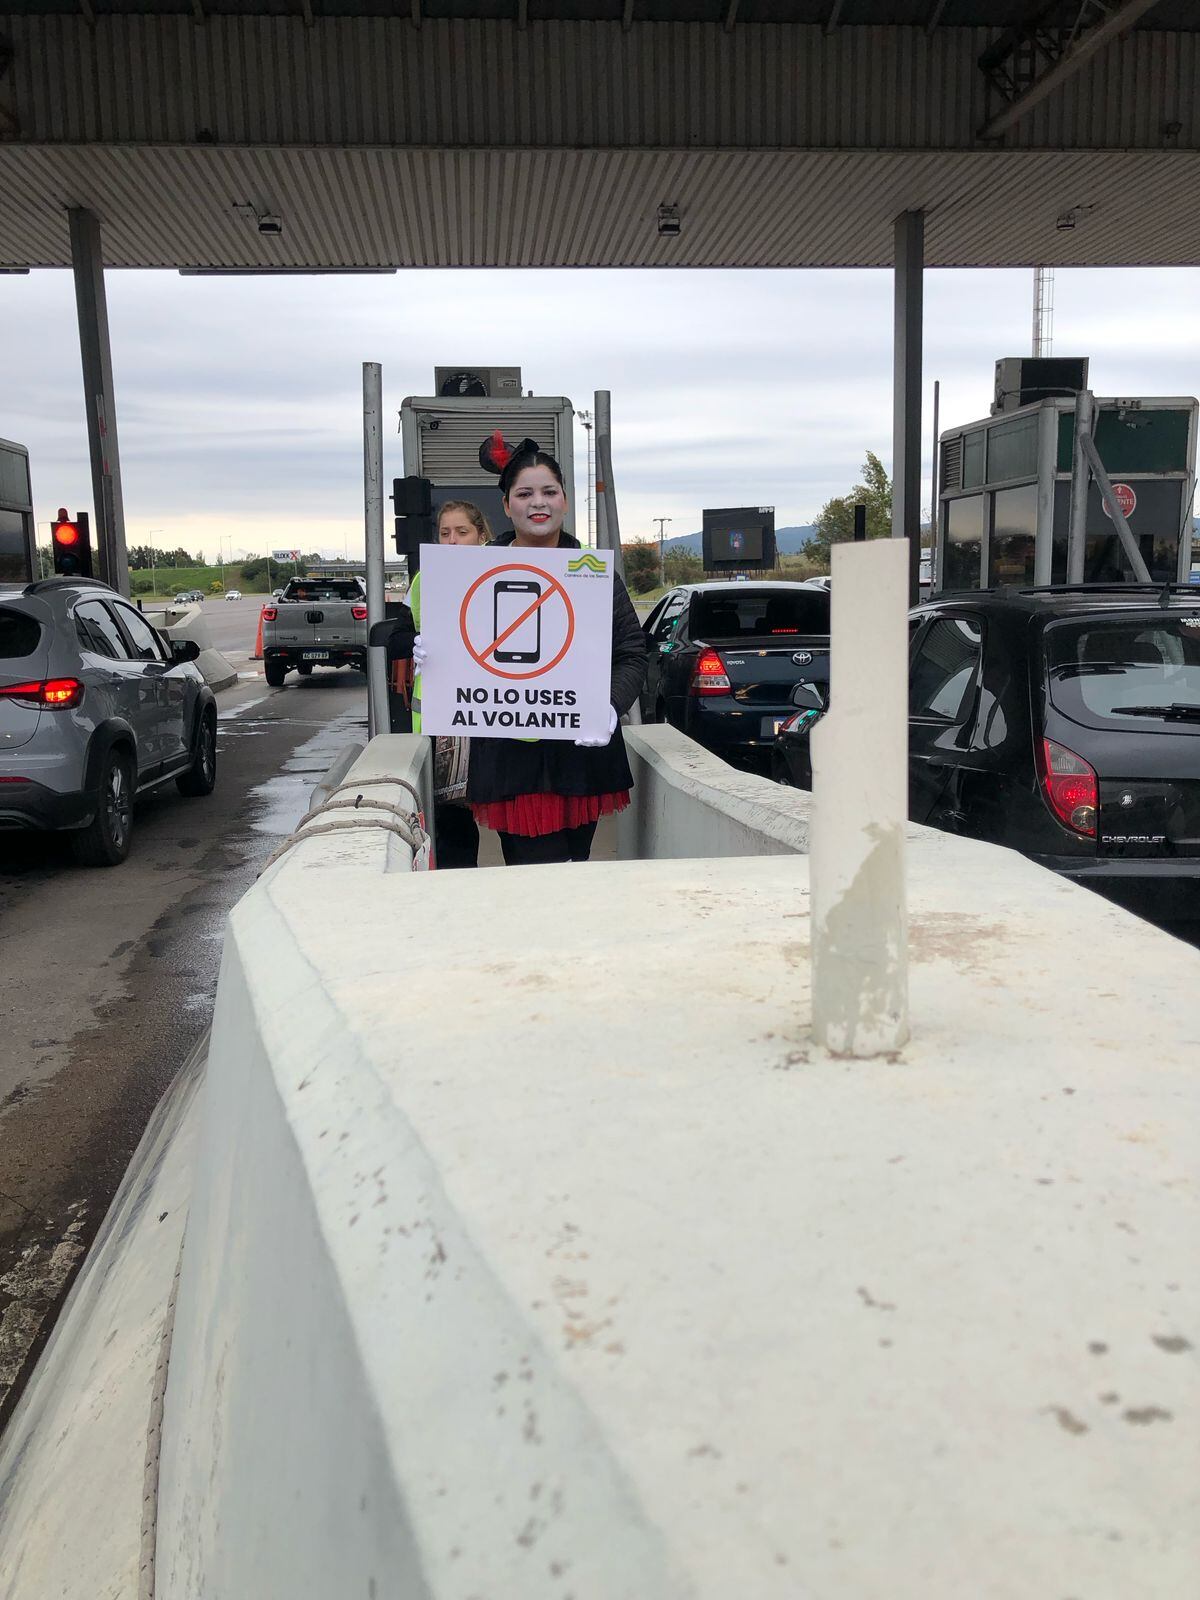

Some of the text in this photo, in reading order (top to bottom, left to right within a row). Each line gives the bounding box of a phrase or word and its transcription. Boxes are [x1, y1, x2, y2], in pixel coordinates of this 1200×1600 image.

[456, 688, 577, 706] NO LO USES
[452, 710, 581, 728] AL VOLANTE
